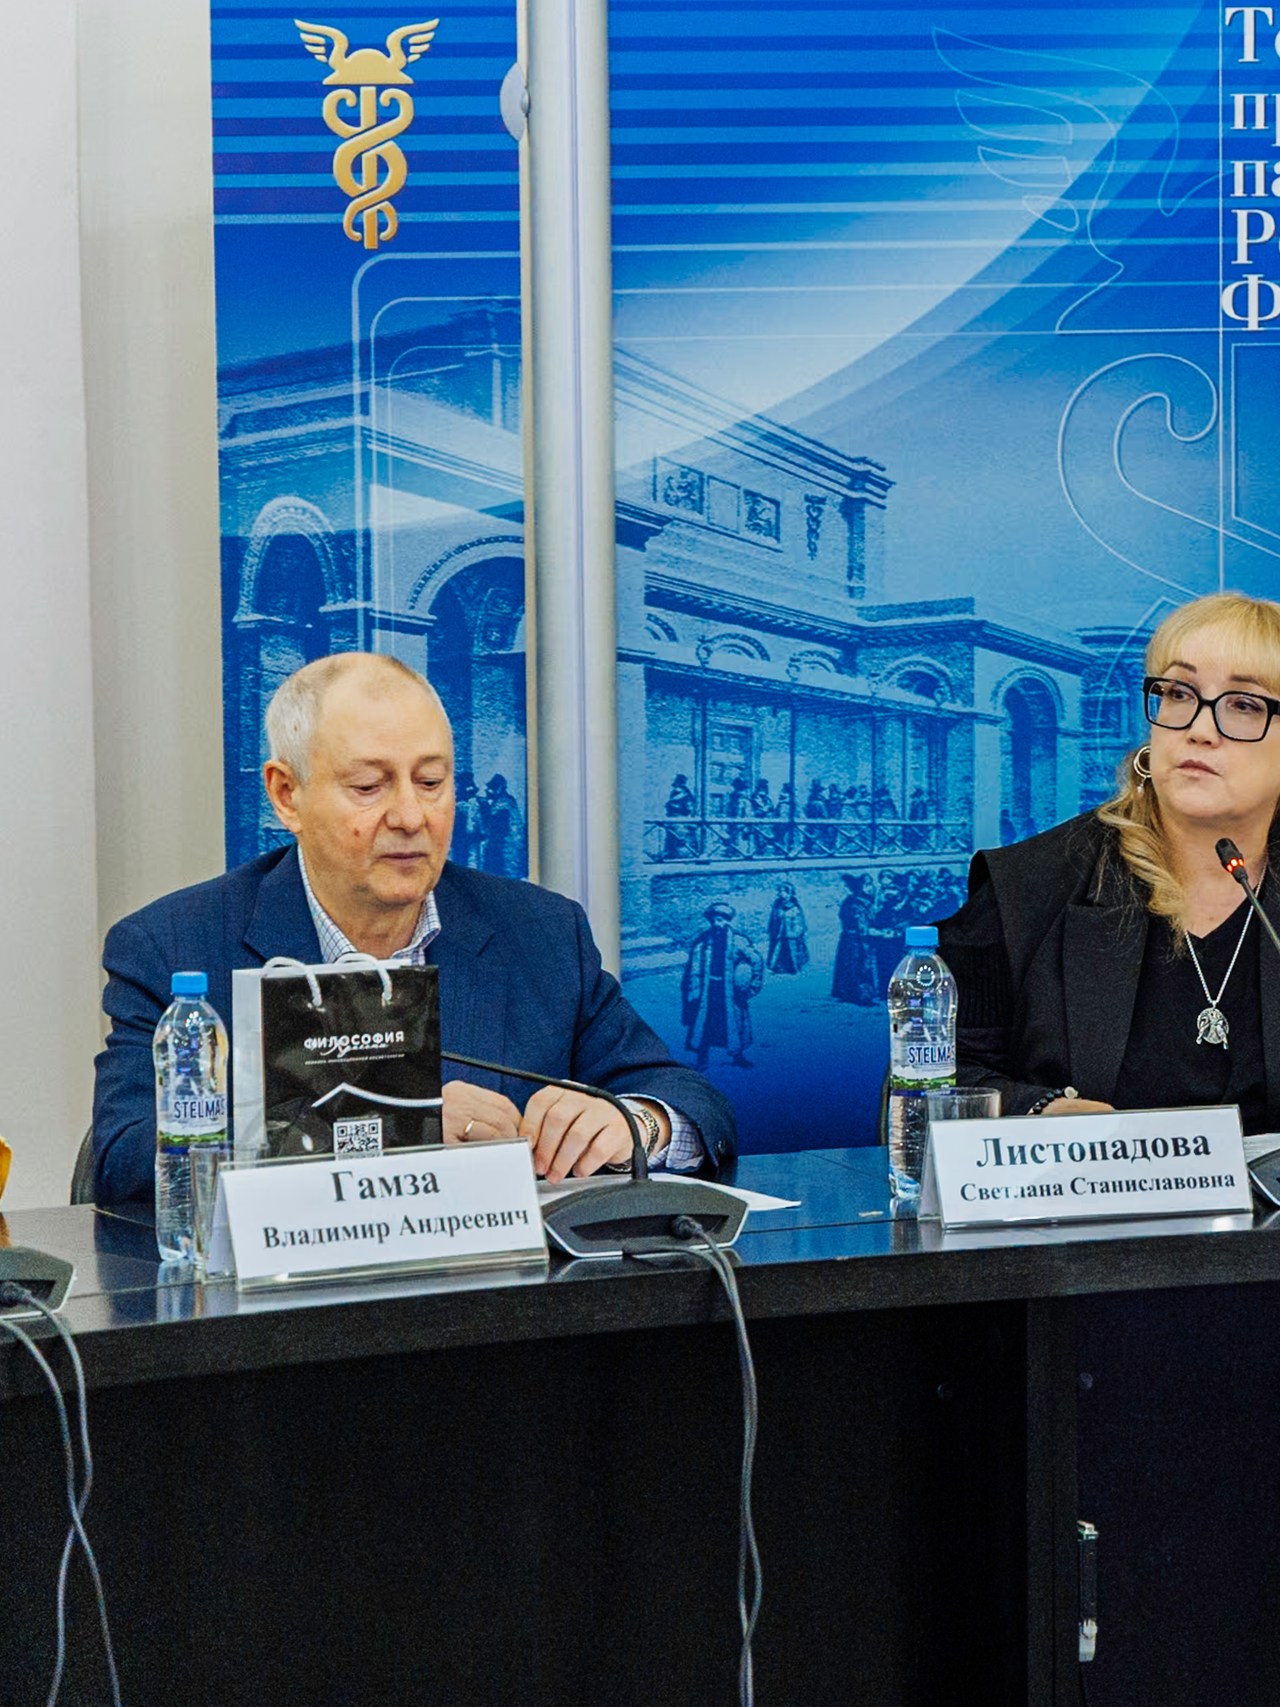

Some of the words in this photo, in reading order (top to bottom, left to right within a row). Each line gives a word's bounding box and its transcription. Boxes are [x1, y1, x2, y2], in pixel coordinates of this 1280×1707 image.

[303, 1030, 405, 1051] ФИЛОСОФИЯ
[976, 1135, 1212, 1168] Листопадова
[329, 1170, 441, 1203] Гамза
[960, 1181, 1065, 1202] Светлана
[1069, 1173, 1236, 1197] Станиславовна
[262, 1220, 391, 1250] Владимир
[398, 1208, 530, 1238] Андреевич
